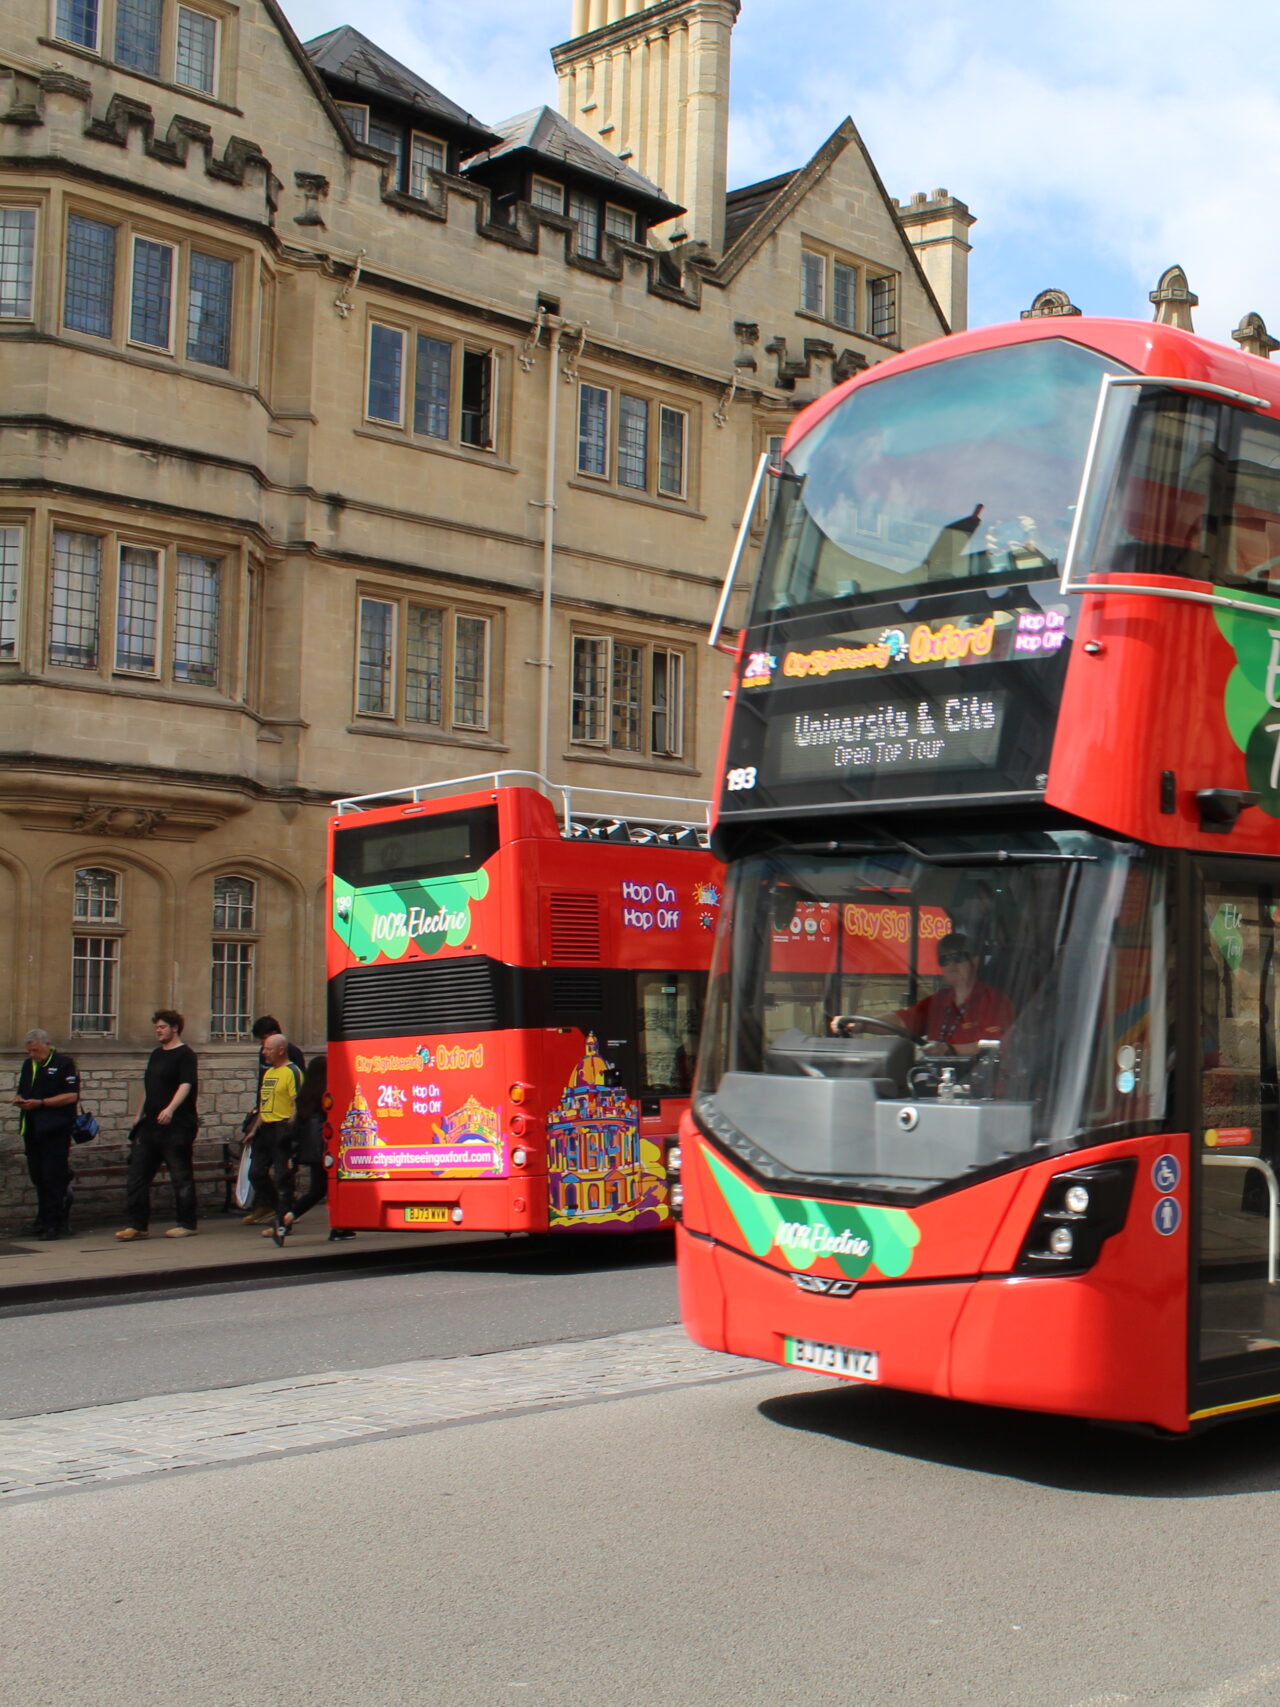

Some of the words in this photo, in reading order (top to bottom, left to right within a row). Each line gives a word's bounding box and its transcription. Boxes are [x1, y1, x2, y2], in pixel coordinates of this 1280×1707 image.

[1018, 612, 1045, 631] Hop
[1045, 610, 1065, 628] On
[909, 617, 994, 664] Oxford
[1015, 633, 1042, 652] Hop
[1043, 630, 1066, 649] Off
[794, 705, 909, 747] University
[917, 702, 935, 734] &
[945, 697, 995, 732] City
[834, 746, 870, 766] Open
[875, 742, 903, 763] Top
[907, 739, 945, 759] Tour
[726, 766, 757, 791] 193
[622, 882, 652, 904] Hop
[655, 882, 676, 903] On
[371, 912, 407, 942] 100%
[408, 904, 467, 938] Electric
[624, 908, 653, 930] Hop
[657, 908, 680, 928] Off
[436, 1043, 484, 1070] Oxford
[377, 1085, 393, 1107] 24
[412, 1085, 427, 1098] Hop
[429, 1084, 440, 1097] On
[412, 1101, 428, 1115] Hop
[429, 1100, 442, 1113] Off
[350, 1150, 491, 1167] www.citysightseeingoxford.com
[775, 1220, 811, 1248] 100%
[811, 1223, 870, 1257] Electric
